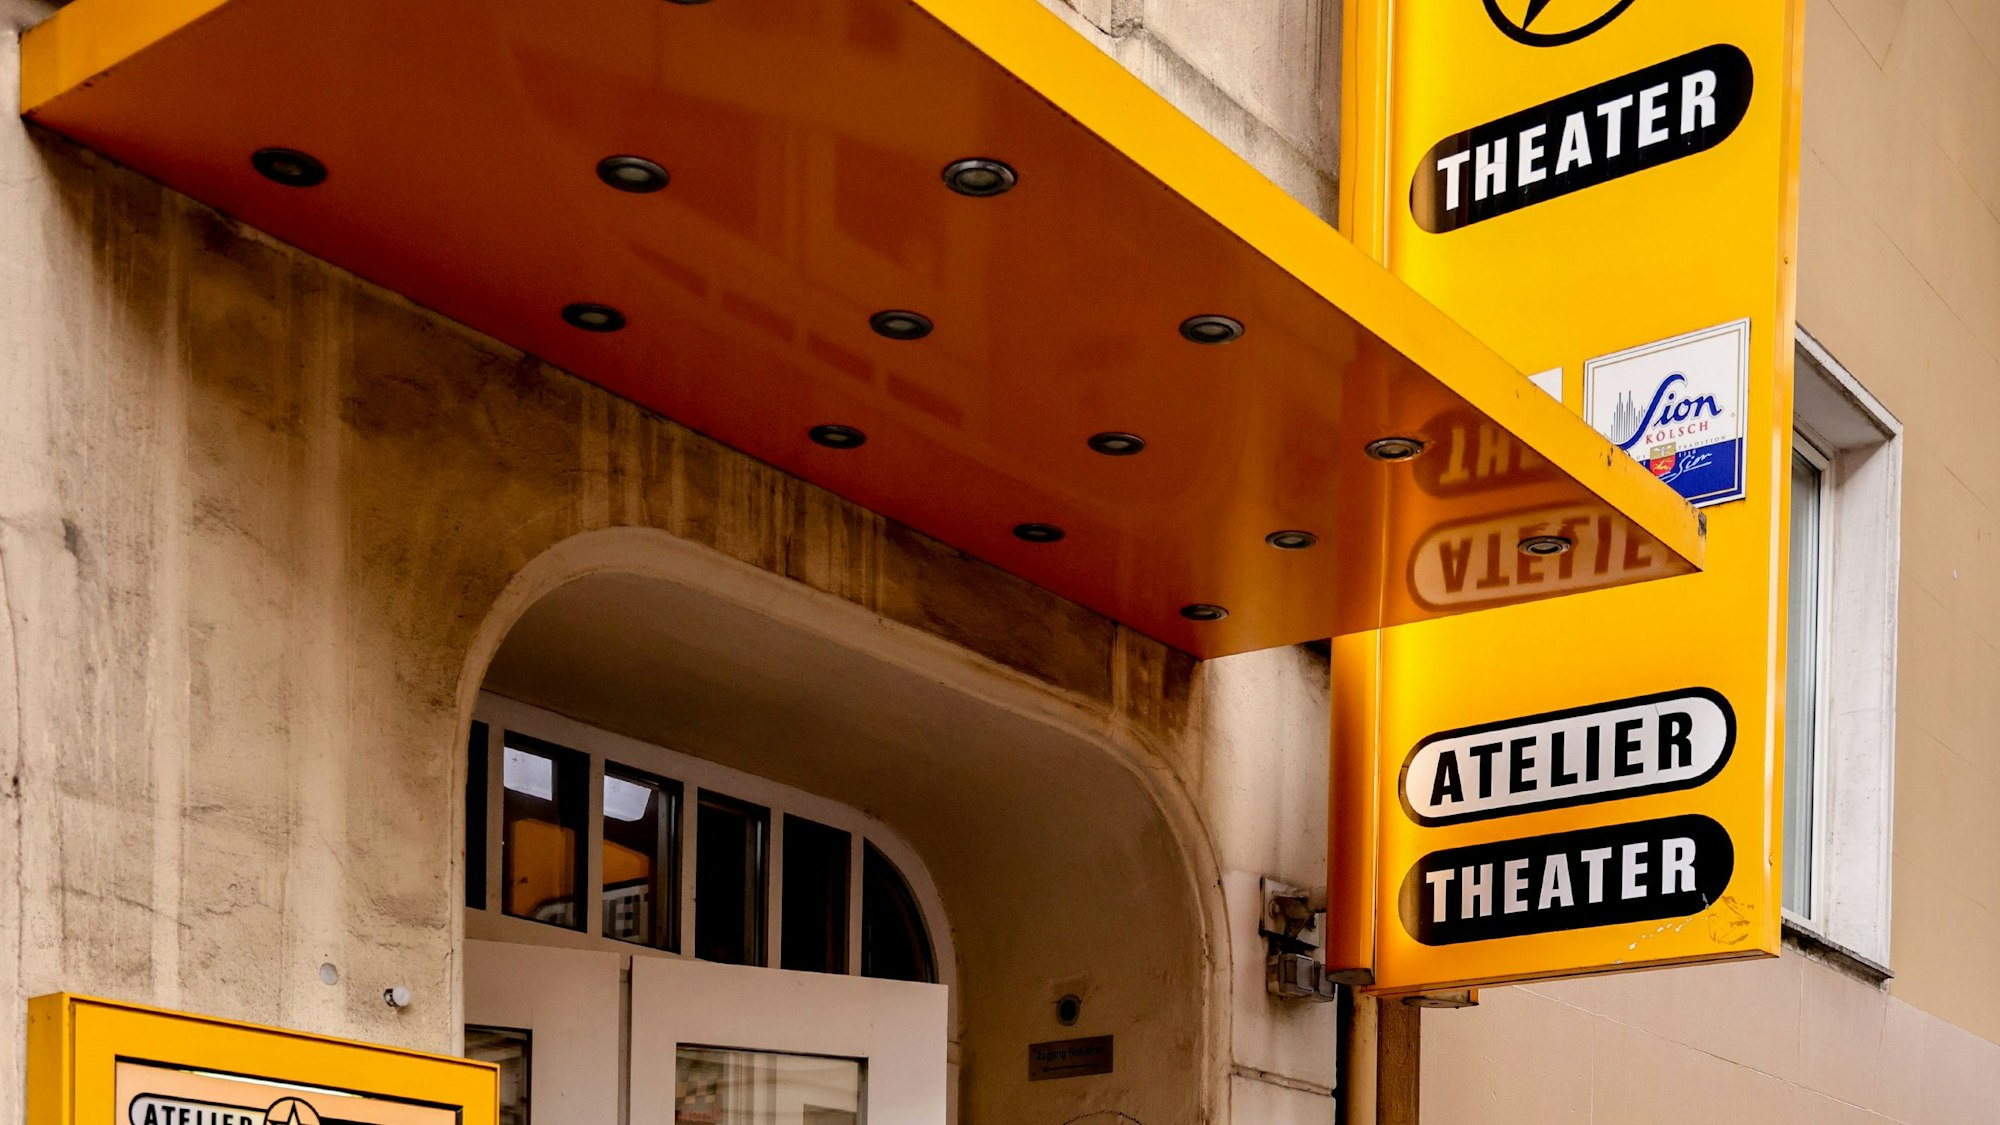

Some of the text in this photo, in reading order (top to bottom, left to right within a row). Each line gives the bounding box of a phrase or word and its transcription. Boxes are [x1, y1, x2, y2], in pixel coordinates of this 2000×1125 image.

[1436, 69, 1717, 211] THEATER
[1615, 373, 1722, 450] Sion
[1645, 421, 1709, 445] KÖLSCH
[1678, 435, 1726, 450] TRADITION
[1429, 711, 1693, 807] ATELIER
[1426, 836, 1697, 924] THEATER
